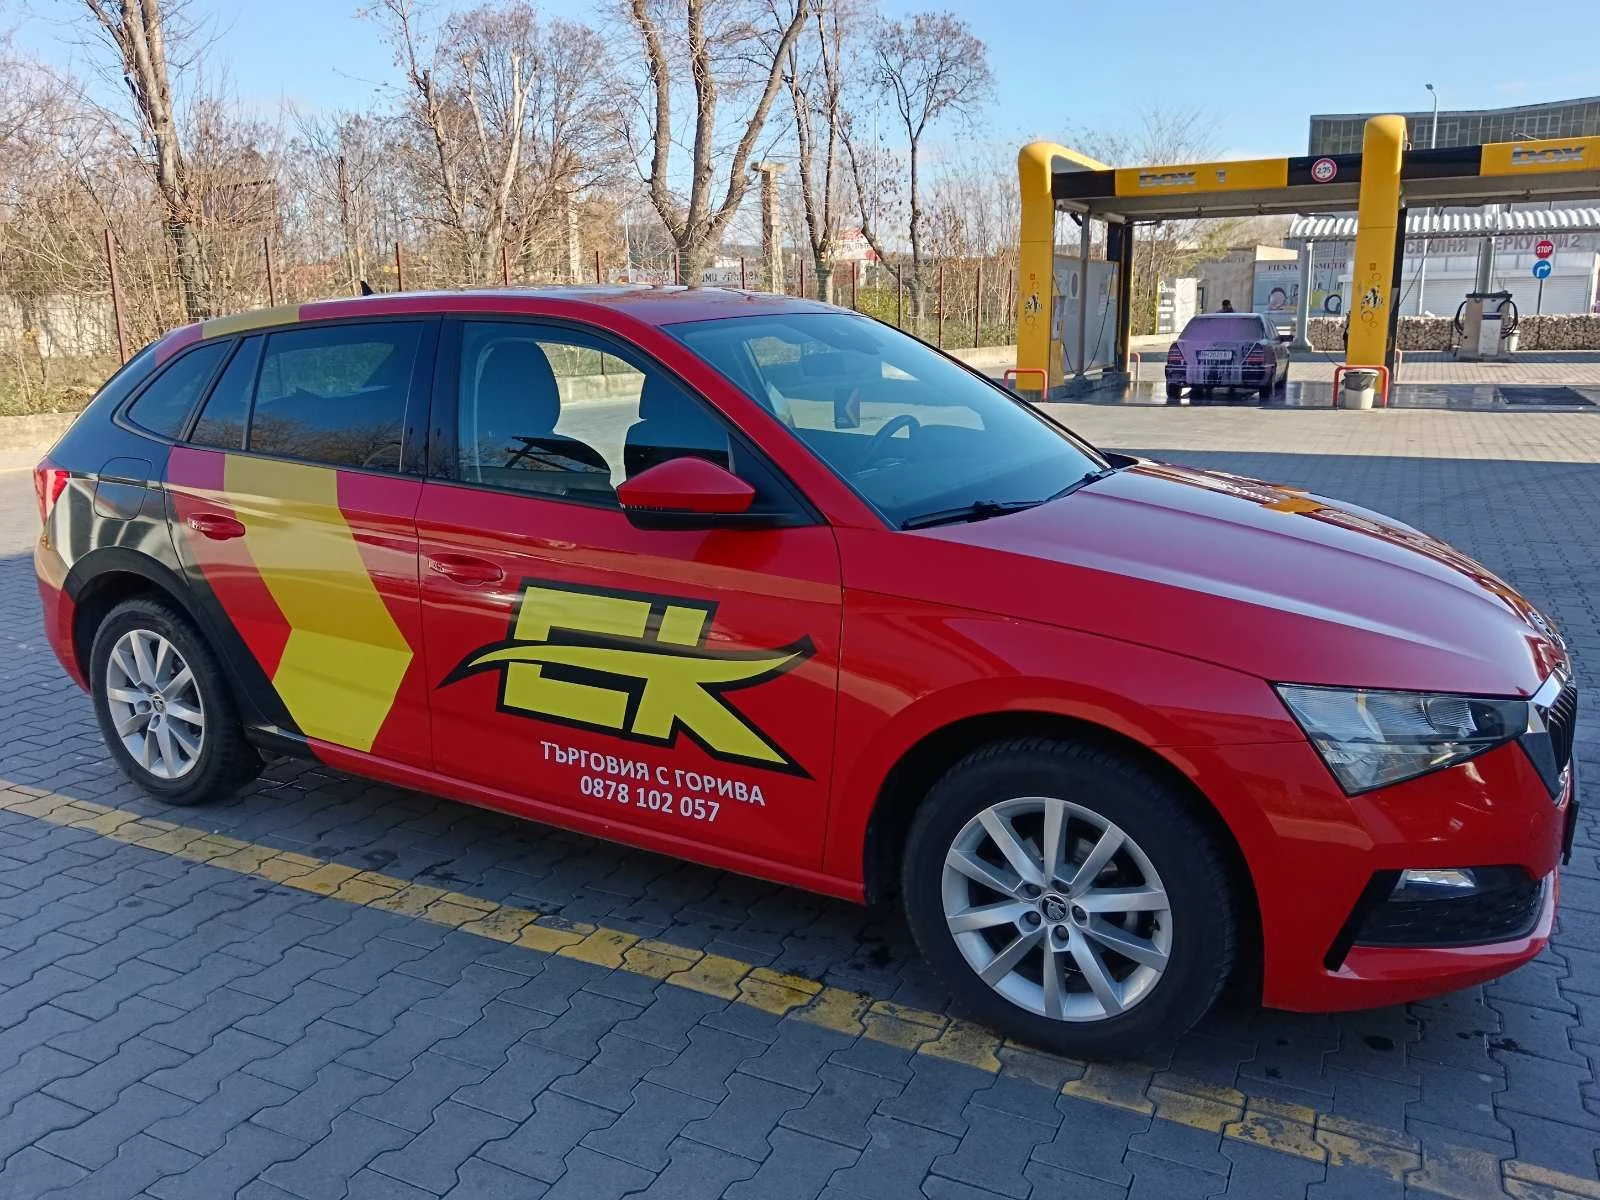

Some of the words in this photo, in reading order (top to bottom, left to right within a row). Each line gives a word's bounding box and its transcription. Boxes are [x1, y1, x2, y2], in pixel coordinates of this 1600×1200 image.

[1536, 245, 1553, 254] STOP
[541, 740, 649, 782] ТЪРГОВИЯ
[655, 766, 670, 786] С
[675, 769, 766, 807] ГОРИВА
[580, 775, 629, 804] 0878
[636, 787, 673, 815] 102
[679, 796, 720, 822] 057
